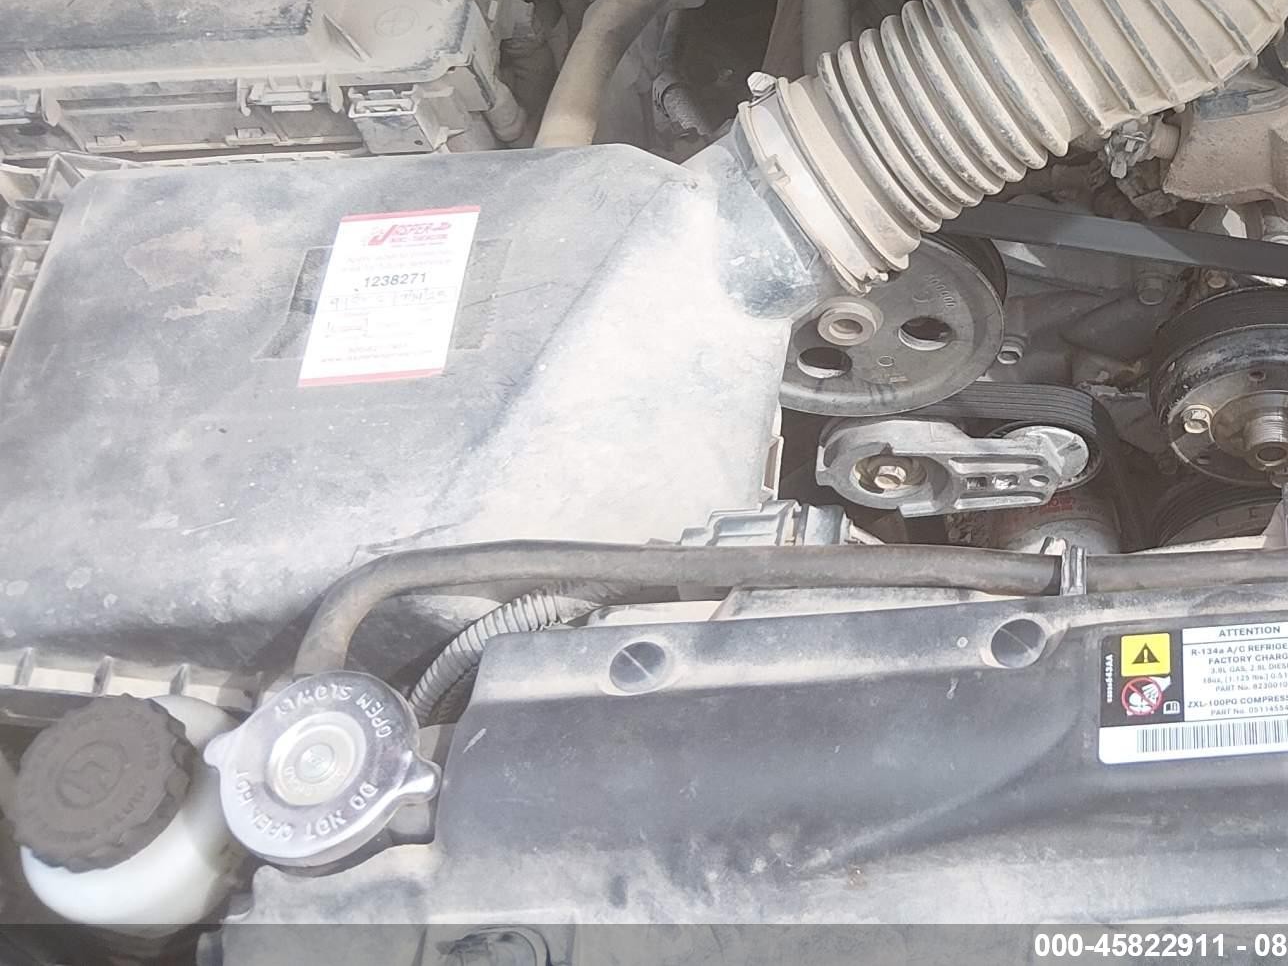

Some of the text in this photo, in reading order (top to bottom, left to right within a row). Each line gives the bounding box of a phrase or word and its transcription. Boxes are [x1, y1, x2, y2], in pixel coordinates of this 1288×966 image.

[364, 272, 427, 289] 1238271
[1218, 625, 1281, 637] ATTENTION
[1191, 647, 1224, 657] R-134a
[1227, 645, 1246, 654] A/C
[1208, 655, 1252, 665] FACTORY
[1215, 685, 1235, 693] PART
[349, 780, 379, 811] DO
[304, 808, 347, 840] NOT
